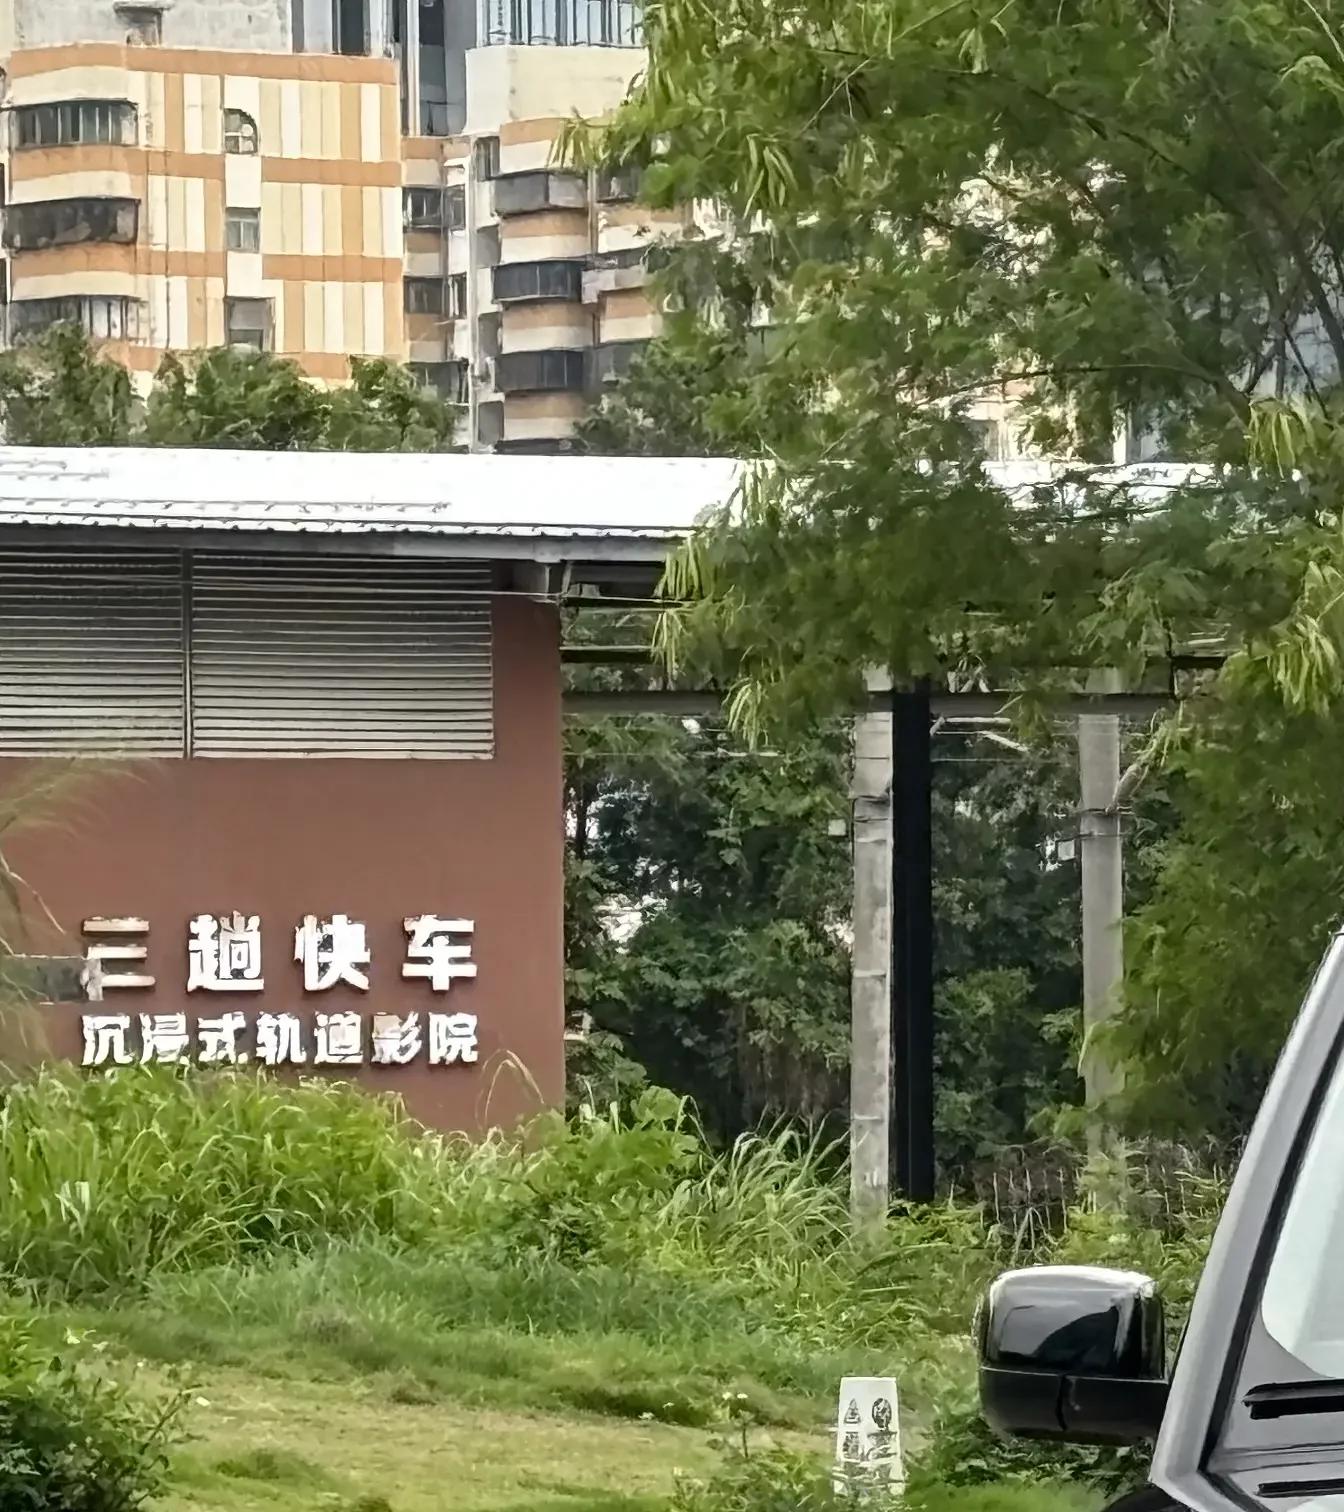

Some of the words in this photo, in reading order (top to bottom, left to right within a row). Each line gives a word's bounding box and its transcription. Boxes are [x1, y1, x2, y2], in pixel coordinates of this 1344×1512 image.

[82, 911, 478, 992] 三趟快车
[82, 1010, 479, 1065] 沉浸式轨道影院
